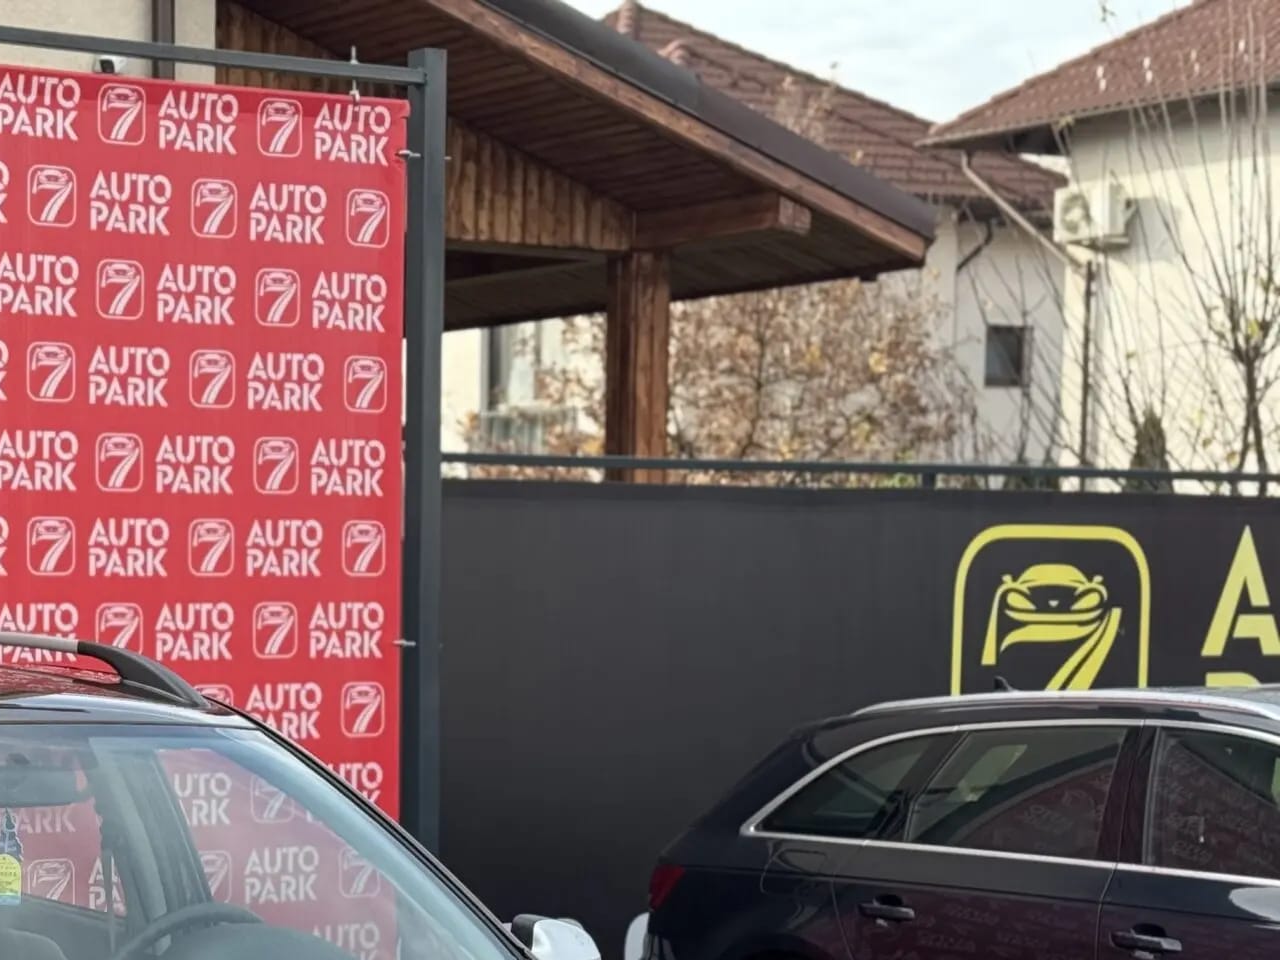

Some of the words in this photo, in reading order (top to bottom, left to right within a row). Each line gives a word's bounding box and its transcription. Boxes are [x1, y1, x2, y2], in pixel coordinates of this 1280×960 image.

[159, 91, 238, 123] AUTO
[314, 104, 391, 134] AUTO
[159, 120, 236, 154] PARK
[315, 131, 388, 166] PARK
[90, 171, 171, 204] AUTO
[250, 183, 327, 214] AUTO
[91, 201, 169, 235] PARK
[250, 212, 324, 244] PARK
[157, 264, 236, 295] AUTO
[312, 272, 387, 303] AUTO
[158, 293, 234, 325] PARK
[313, 300, 384, 332] PARK
[89, 346, 170, 377] AUTO
[248, 352, 324, 382] AUTO
[89, 375, 168, 407] PARK
[248, 381, 322, 411] PARK
[156, 436, 235, 464] AUTO
[311, 439, 385, 468] AUTO
[157, 464, 232, 494] PARK
[311, 467, 383, 496] PARK
[88, 518, 169, 547] AUTO
[246, 519, 323, 547] AUTO
[89, 548, 167, 576] PARK
[247, 549, 320, 576] PARK
[156, 602, 234, 631] AUTO
[309, 602, 384, 629] AUTO
[156, 632, 232, 661] PARK
[310, 629, 382, 658] PARK
[246, 682, 322, 713] AUTO
[244, 846, 318, 877] AUTO
[245, 874, 318, 904] PARK
